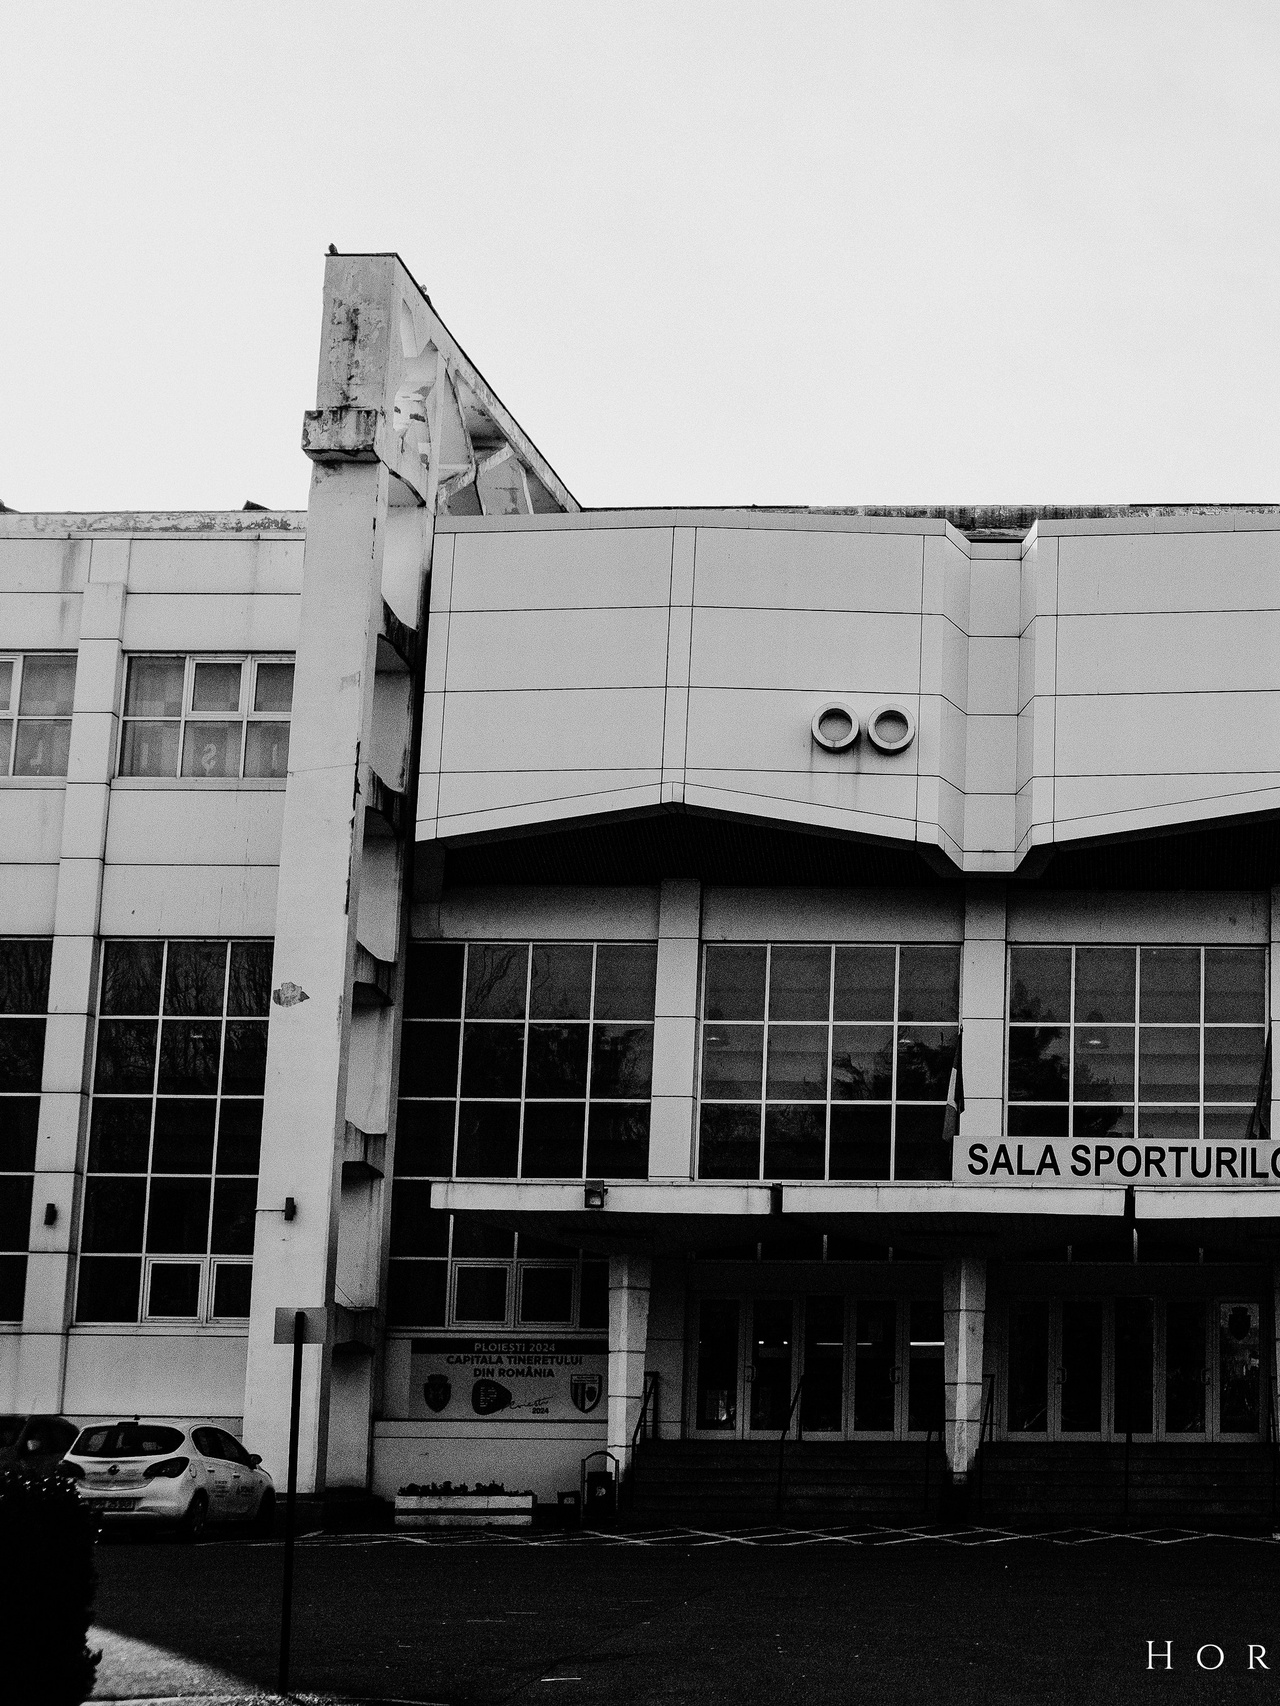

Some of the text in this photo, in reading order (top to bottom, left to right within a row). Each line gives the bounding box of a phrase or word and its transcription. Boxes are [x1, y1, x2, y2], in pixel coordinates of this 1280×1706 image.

[967, 1143, 1061, 1176] SALA
[529, 1342, 556, 1352] 2024
[446, 1355, 583, 1365] CAPITALA TINERETULUI
[473, 1366, 555, 1378] DIN ROMÂNIA
